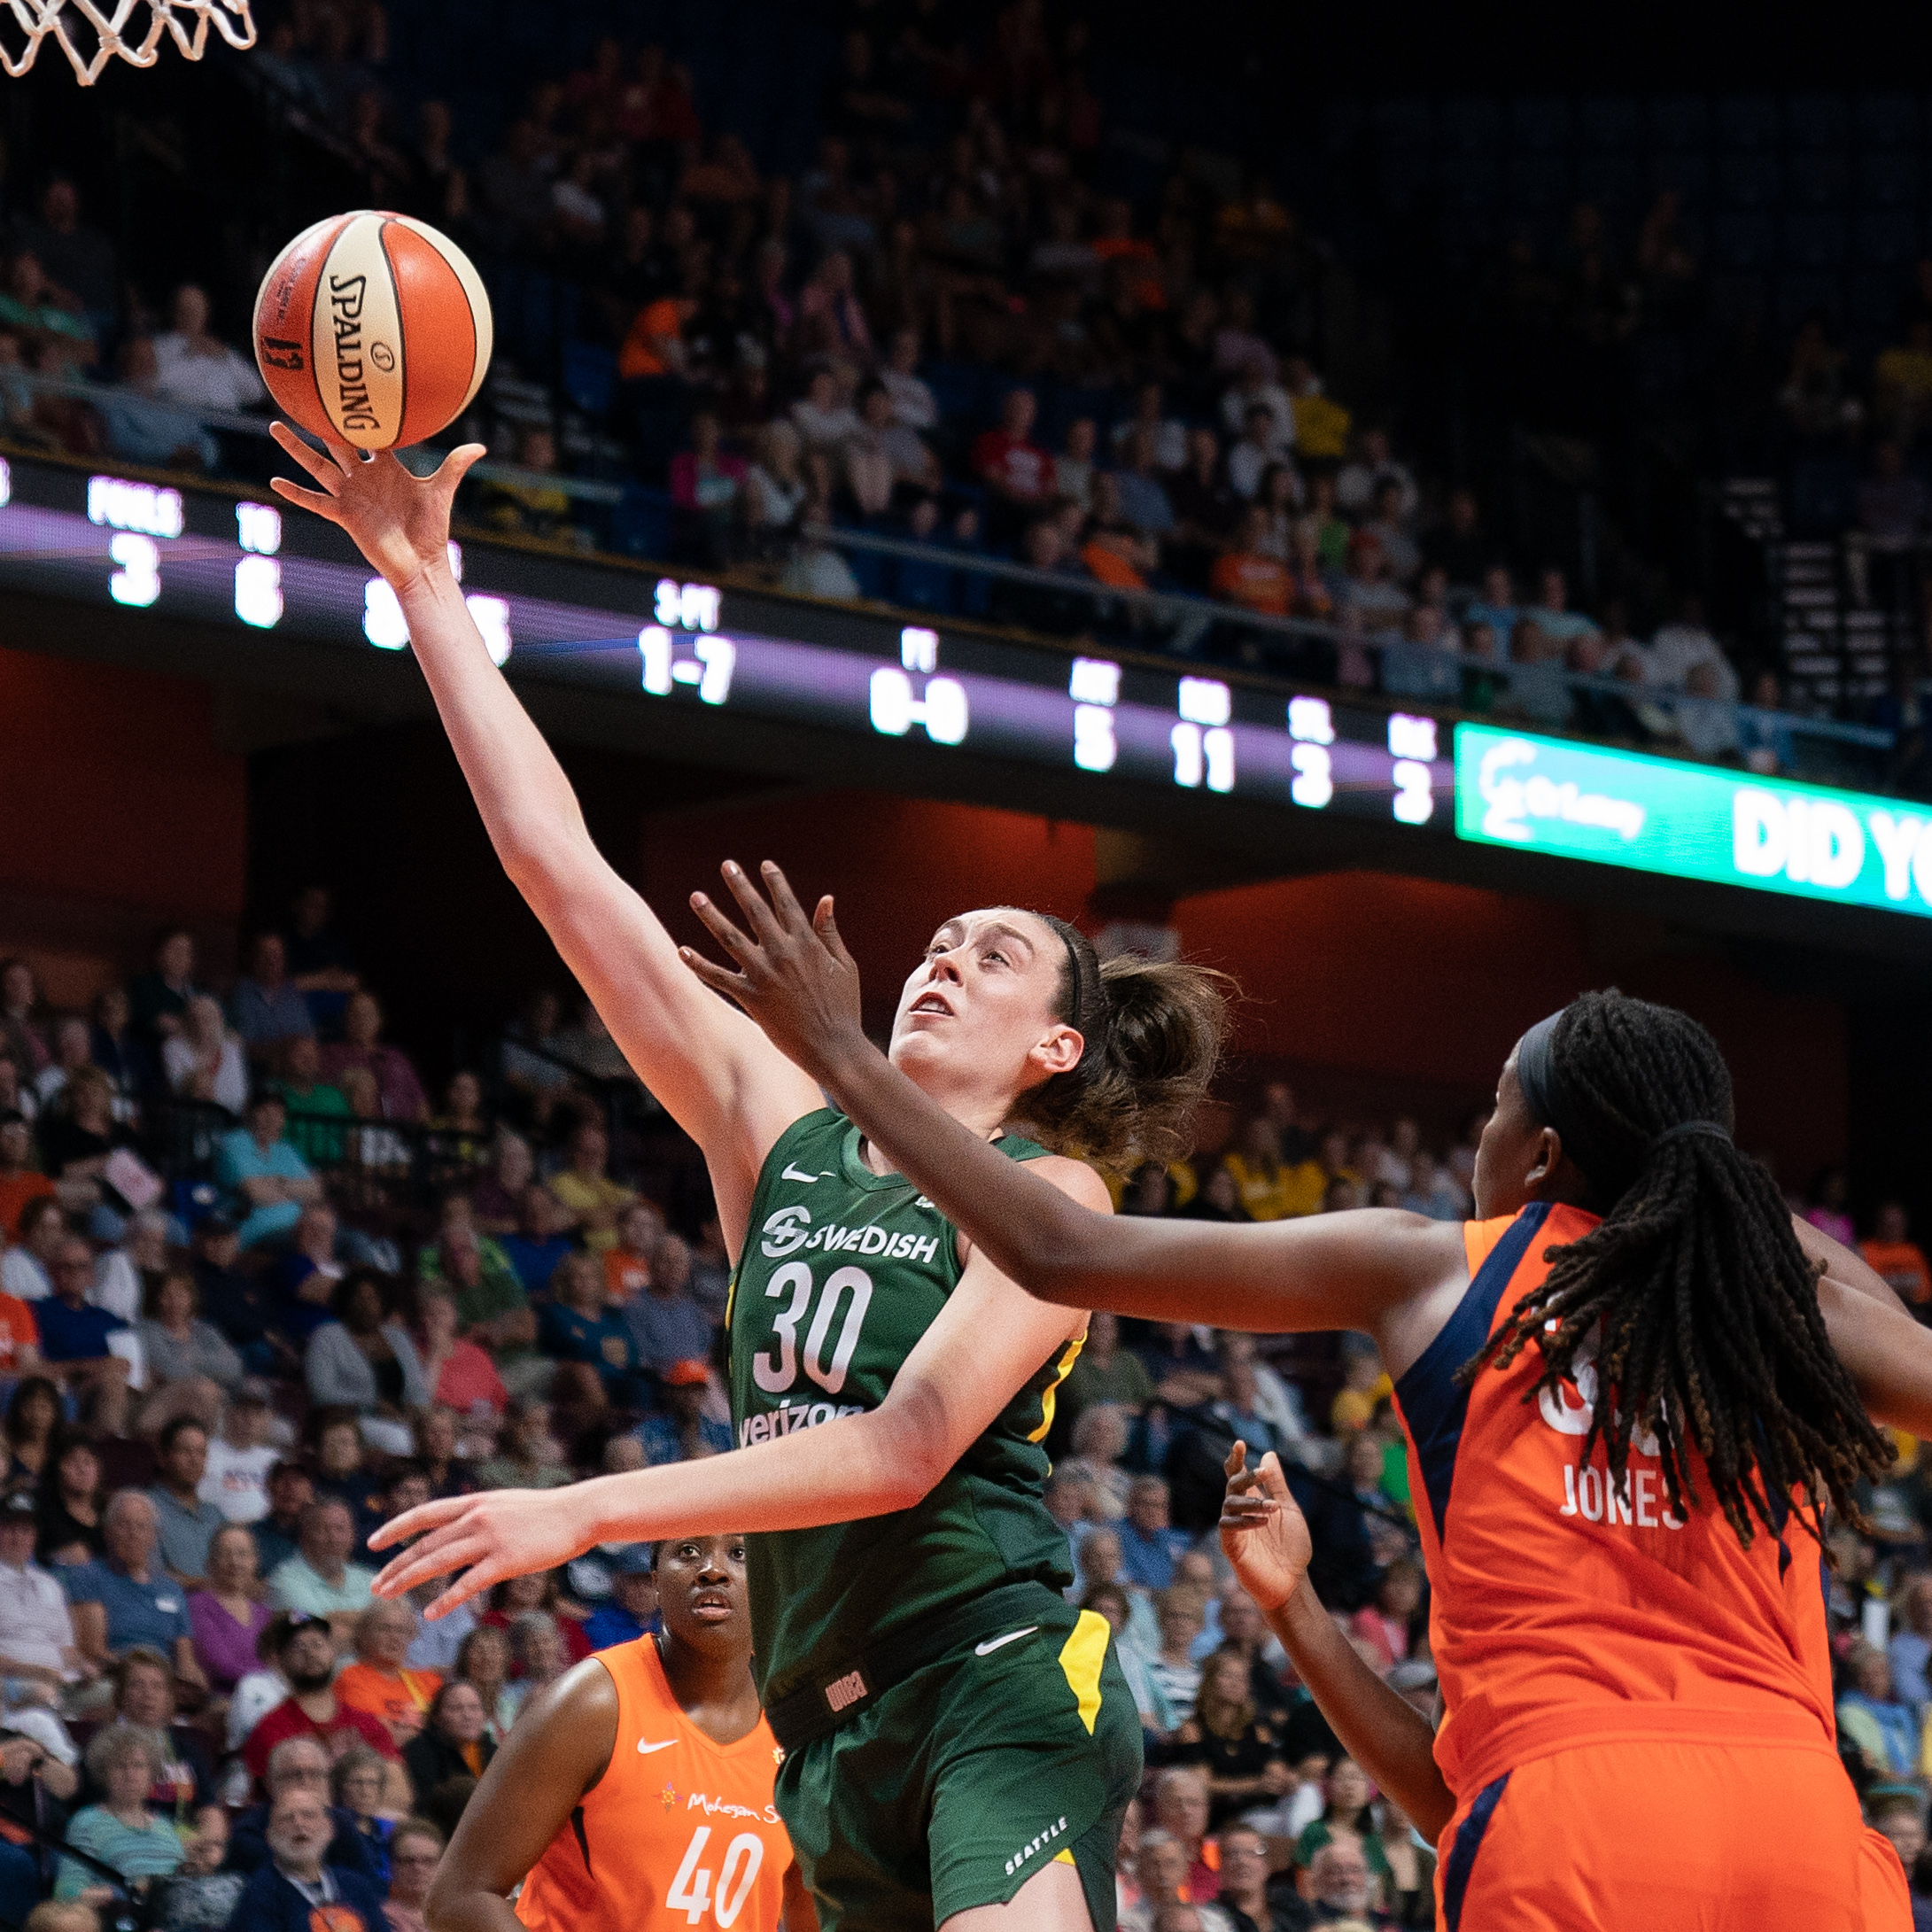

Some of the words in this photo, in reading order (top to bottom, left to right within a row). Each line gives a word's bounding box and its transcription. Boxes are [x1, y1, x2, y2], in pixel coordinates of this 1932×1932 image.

[330, 275, 381, 432] SPALDING
[109, 531, 161, 608] 3
[638, 625, 736, 705] 1-7
[1170, 722, 1236, 793] 11
[1733, 788, 1865, 889] DID
[804, 1223, 939, 1264] SWEDISH
[753, 1261, 873, 1395] 30
[687, 1792, 761, 1819] Mohegan
[763, 1804, 781, 1824] S
[1005, 1814, 1068, 1877] SEATTLE
[665, 1826, 764, 1929] 40
